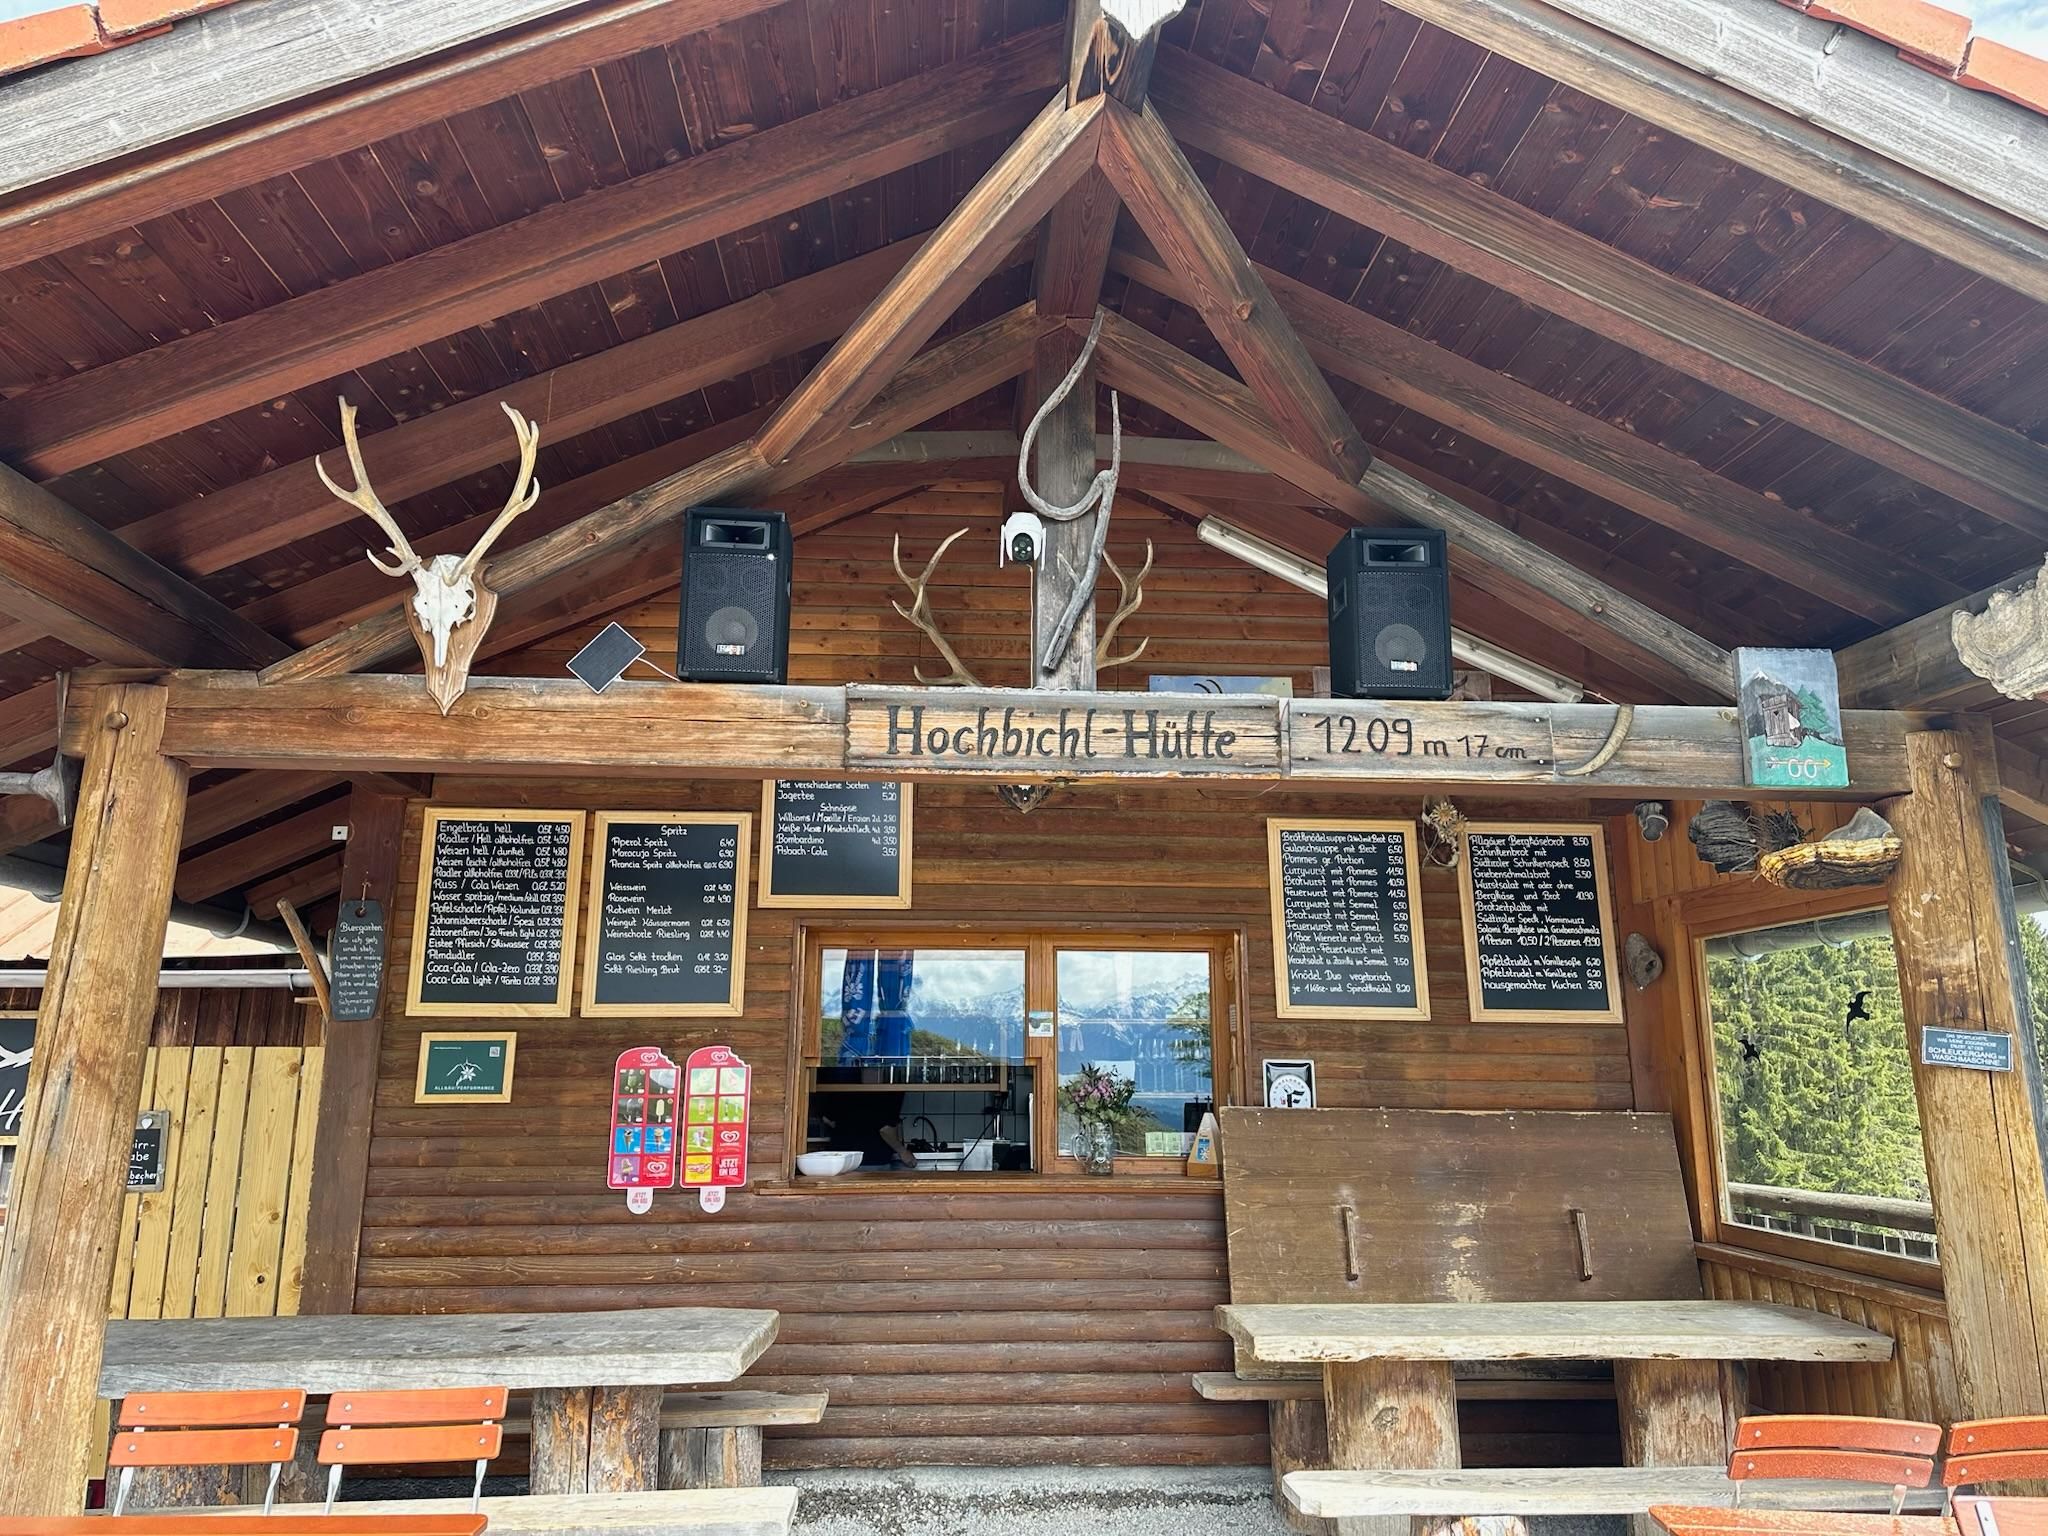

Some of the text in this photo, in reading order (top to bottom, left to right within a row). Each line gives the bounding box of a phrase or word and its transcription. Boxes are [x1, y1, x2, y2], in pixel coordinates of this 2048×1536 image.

[886, 704, 1236, 759] Hochbichl-Hütte
[1314, 716, 1526, 758] 1209 m 17 cm
[495, 824, 512, 832] hell
[660, 826, 688, 837] Spritz
[611, 836, 668, 849] Aperol Spritz
[776, 834, 824, 844] Bombardino
[1469, 835, 1565, 847] Allgäuer Bergkäsebrot
[437, 845, 469, 856] Weizen
[612, 848, 677, 858] Maracuja Spritz
[1283, 842, 1378, 854] Gulaschsuppe mit Brot
[1472, 846, 1547, 856] Schinkenbrot mit
[436, 857, 463, 866] Weizen
[1283, 853, 1364, 864] Pommes Portion
[1473, 857, 1509, 868] Südtiroler
[642, 860, 662, 870] Spritz
[1284, 864, 1378, 877] Currywurst mit Pommes
[434, 867, 461, 878] Radler
[433, 879, 519, 890] Russ Cola Weizen
[1284, 875, 1378, 886] Bratwurst mit Pommes
[1474, 879, 1520, 889] Wurstsalat
[1522, 881, 1534, 889] mit
[1556, 880, 1574, 890] ohne
[610, 882, 646, 892] Weisswein
[1285, 887, 1378, 898] Feuerwurst mit Pommes
[433, 891, 461, 901] Wasser
[1524, 892, 1538, 900] und
[1542, 890, 1560, 900] Brot
[606, 904, 672, 914] Rotwein Merlot
[1286, 898, 1330, 910] Currywurst
[1349, 900, 1378, 908] Semmel
[1536, 903, 1548, 912] mit
[1286, 909, 1380, 920] Bratwurst mit Semmel
[1477, 913, 1515, 922] Südtiroler
[340, 922, 383, 934] Biergarten
[606, 917, 636, 928] Weingut
[1286, 920, 1380, 932] Feuerwurst mit Semmel
[606, 928, 690, 940] Weinschorle Riesling
[1350, 934, 1361, 942] mit
[1364, 933, 1384, 943] Brot
[428, 938, 453, 948] Eistee
[427, 950, 475, 960] Almdudler
[1371, 946, 1384, 954] mit
[606, 952, 626, 961] Glas
[630, 952, 646, 961] Sekt
[427, 962, 472, 973] Coca-Cola
[660, 964, 680, 974] Brut
[426, 974, 468, 984] Coca-Cola
[472, 975, 492, 986] light
[1291, 970, 1322, 980] Knödel
[1324, 970, 1342, 980] Duo
[1551, 979, 1582, 990] Kuchen
[1928, 1047, 1996, 1059] SCHLEUDERGANG
